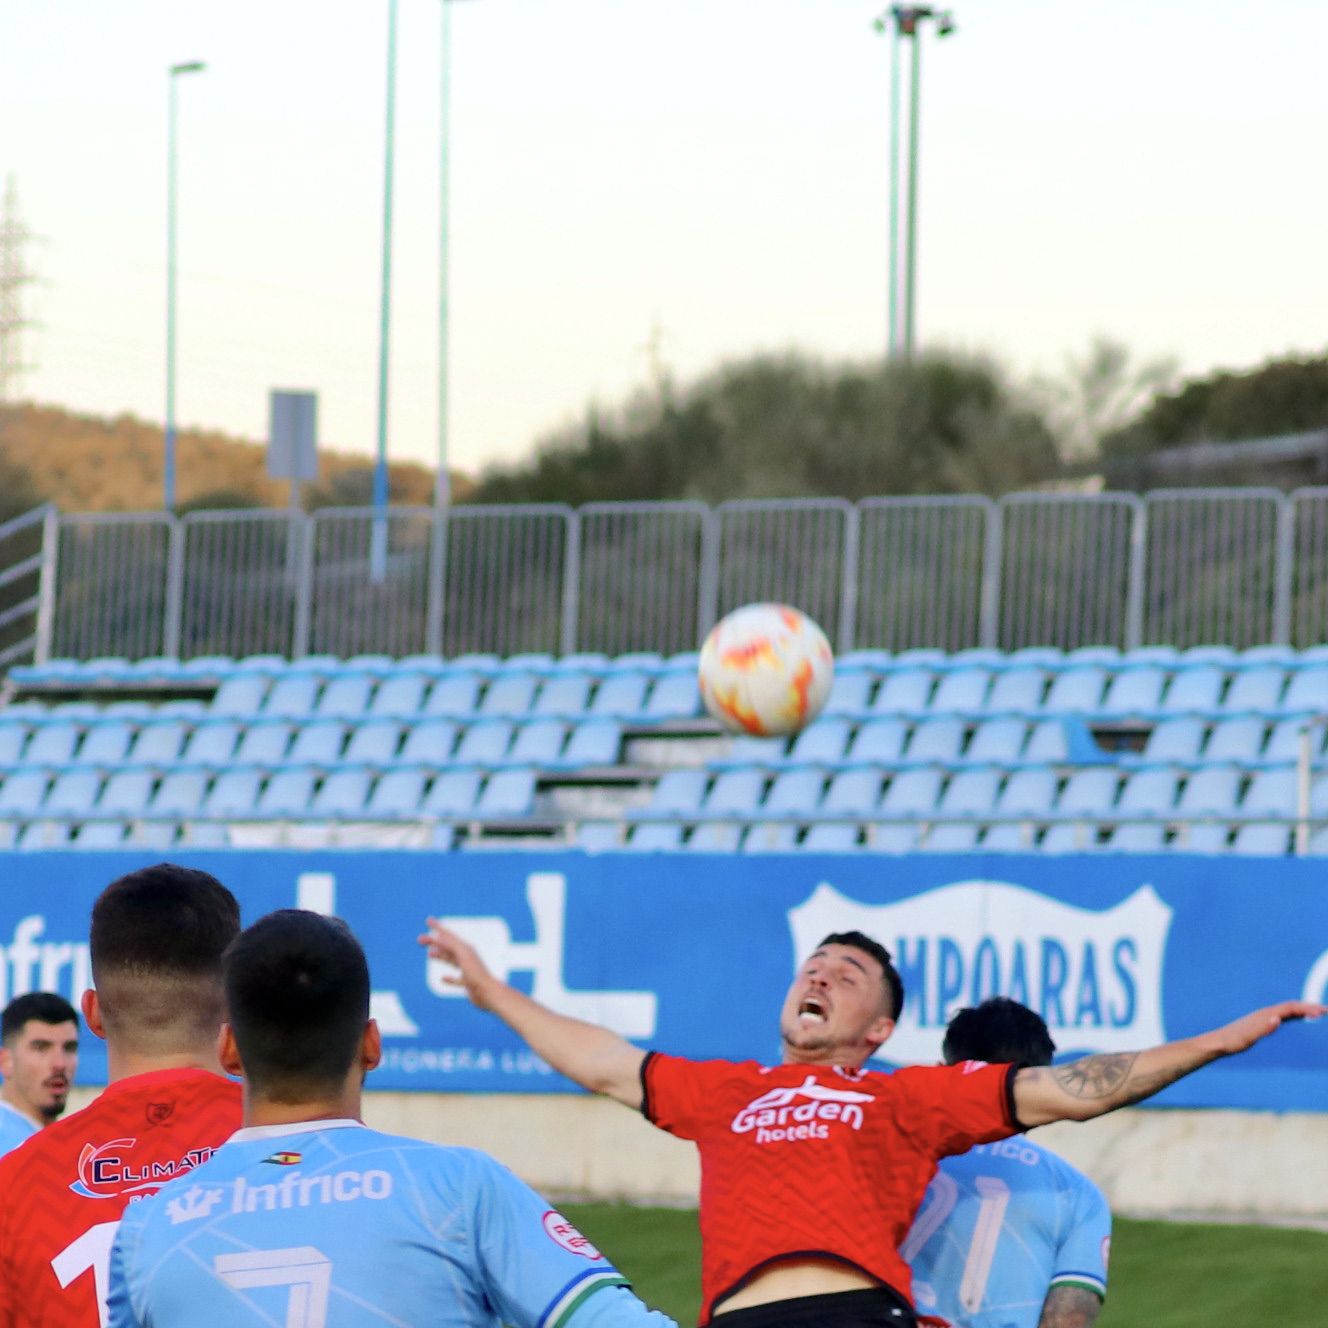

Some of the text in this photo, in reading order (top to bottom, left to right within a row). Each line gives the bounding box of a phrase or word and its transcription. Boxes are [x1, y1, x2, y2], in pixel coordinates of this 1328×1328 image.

[895, 936, 1138, 1029] MPOARAS
[732, 1100, 864, 1133] Garden
[755, 1120, 830, 1144] hotels
[232, 1168, 393, 1215] Infrico
